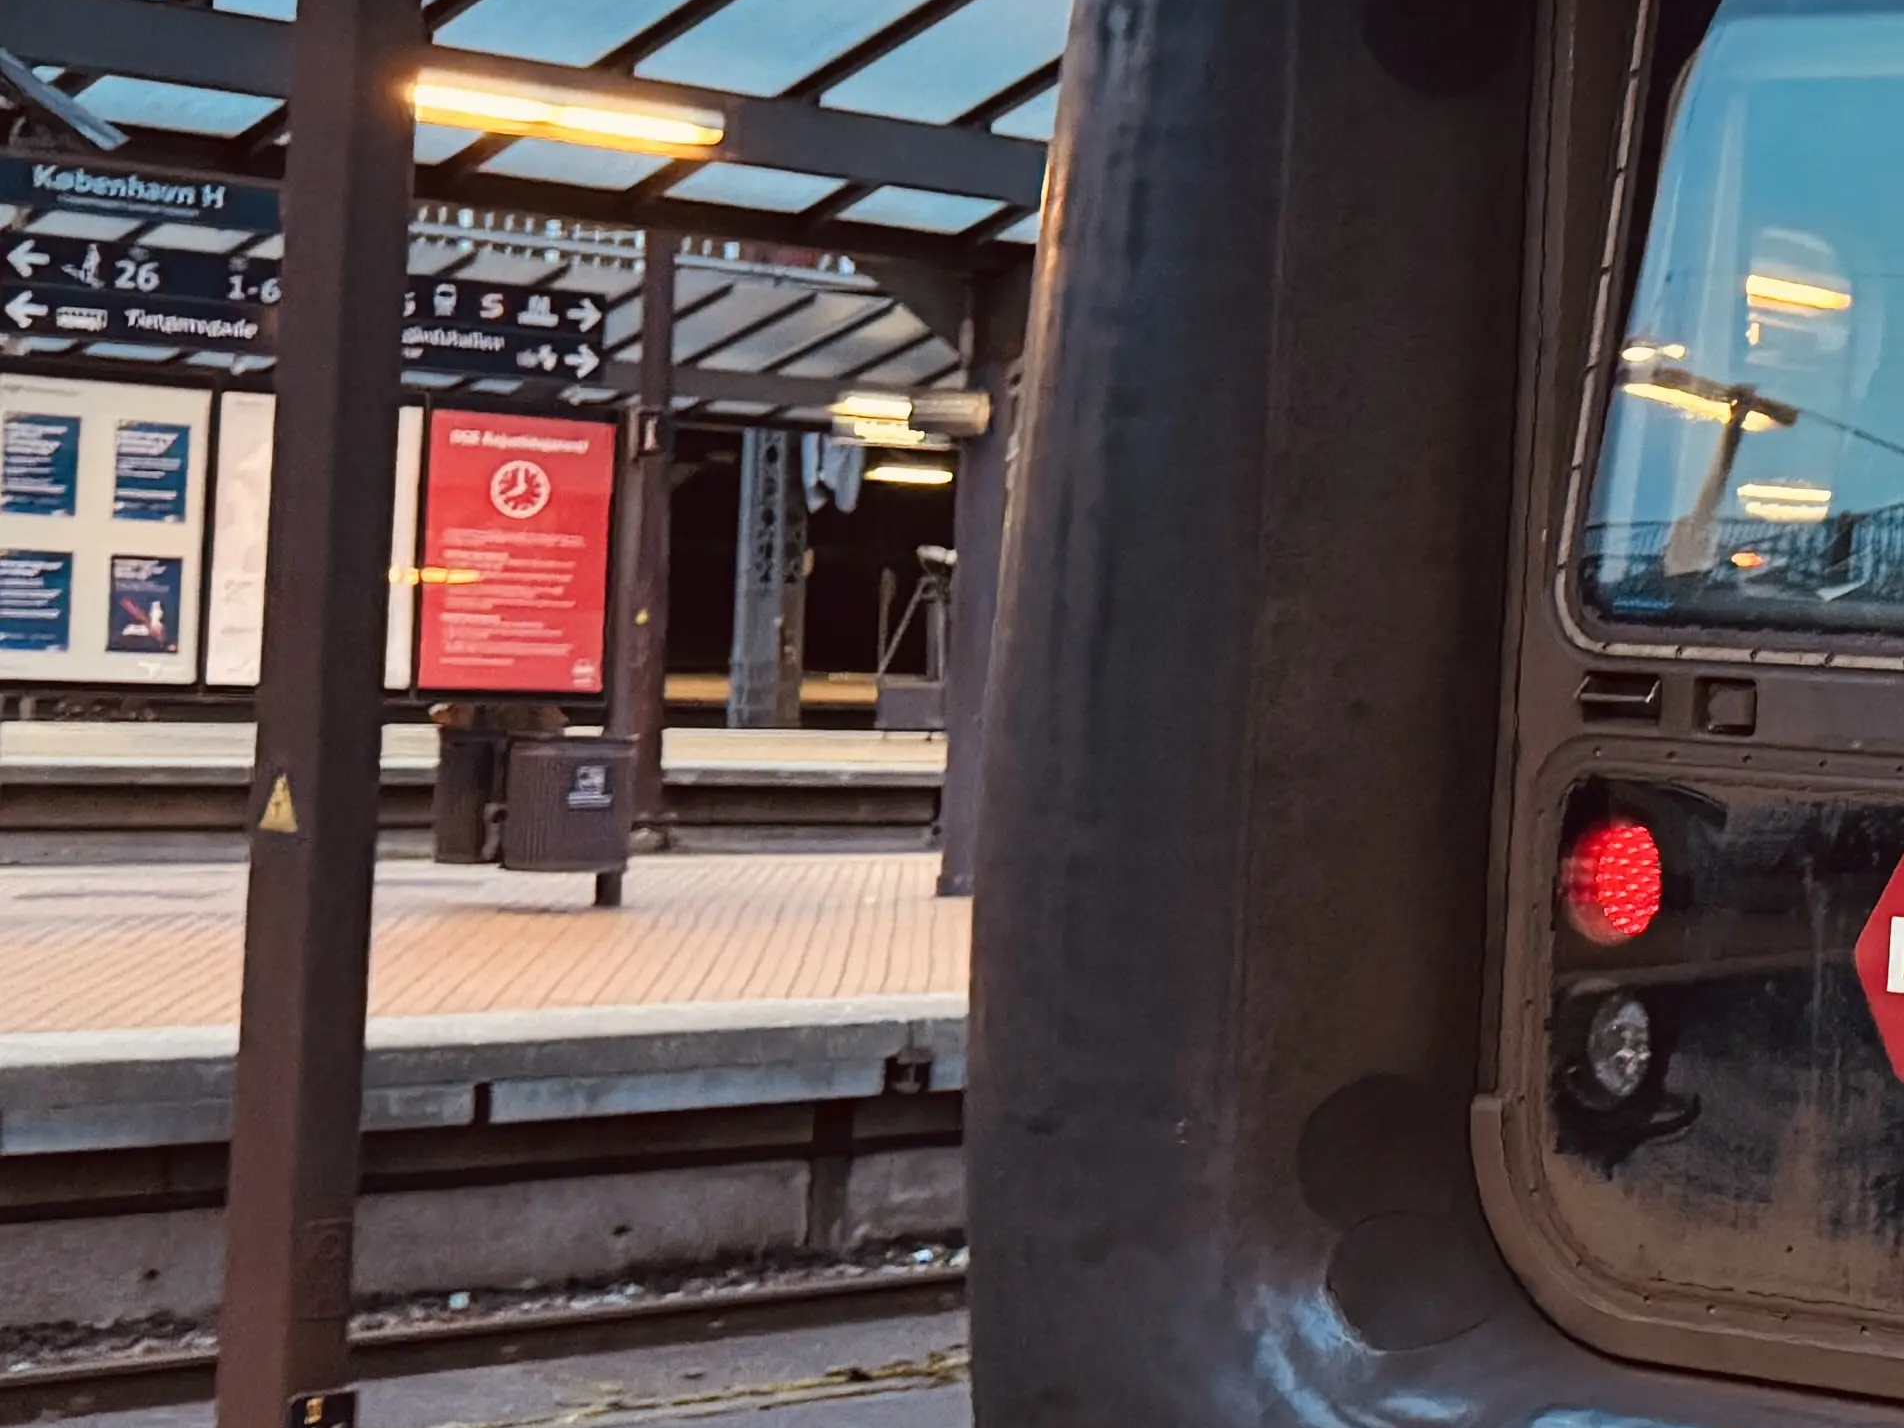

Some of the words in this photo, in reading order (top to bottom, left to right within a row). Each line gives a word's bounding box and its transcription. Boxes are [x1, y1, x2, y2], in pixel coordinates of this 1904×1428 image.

[32, 164, 196, 205] København
[202, 183, 227, 209] H
[114, 259, 160, 292] 26
[227, 274, 282, 304] 1-6
[479, 292, 504, 319] S
